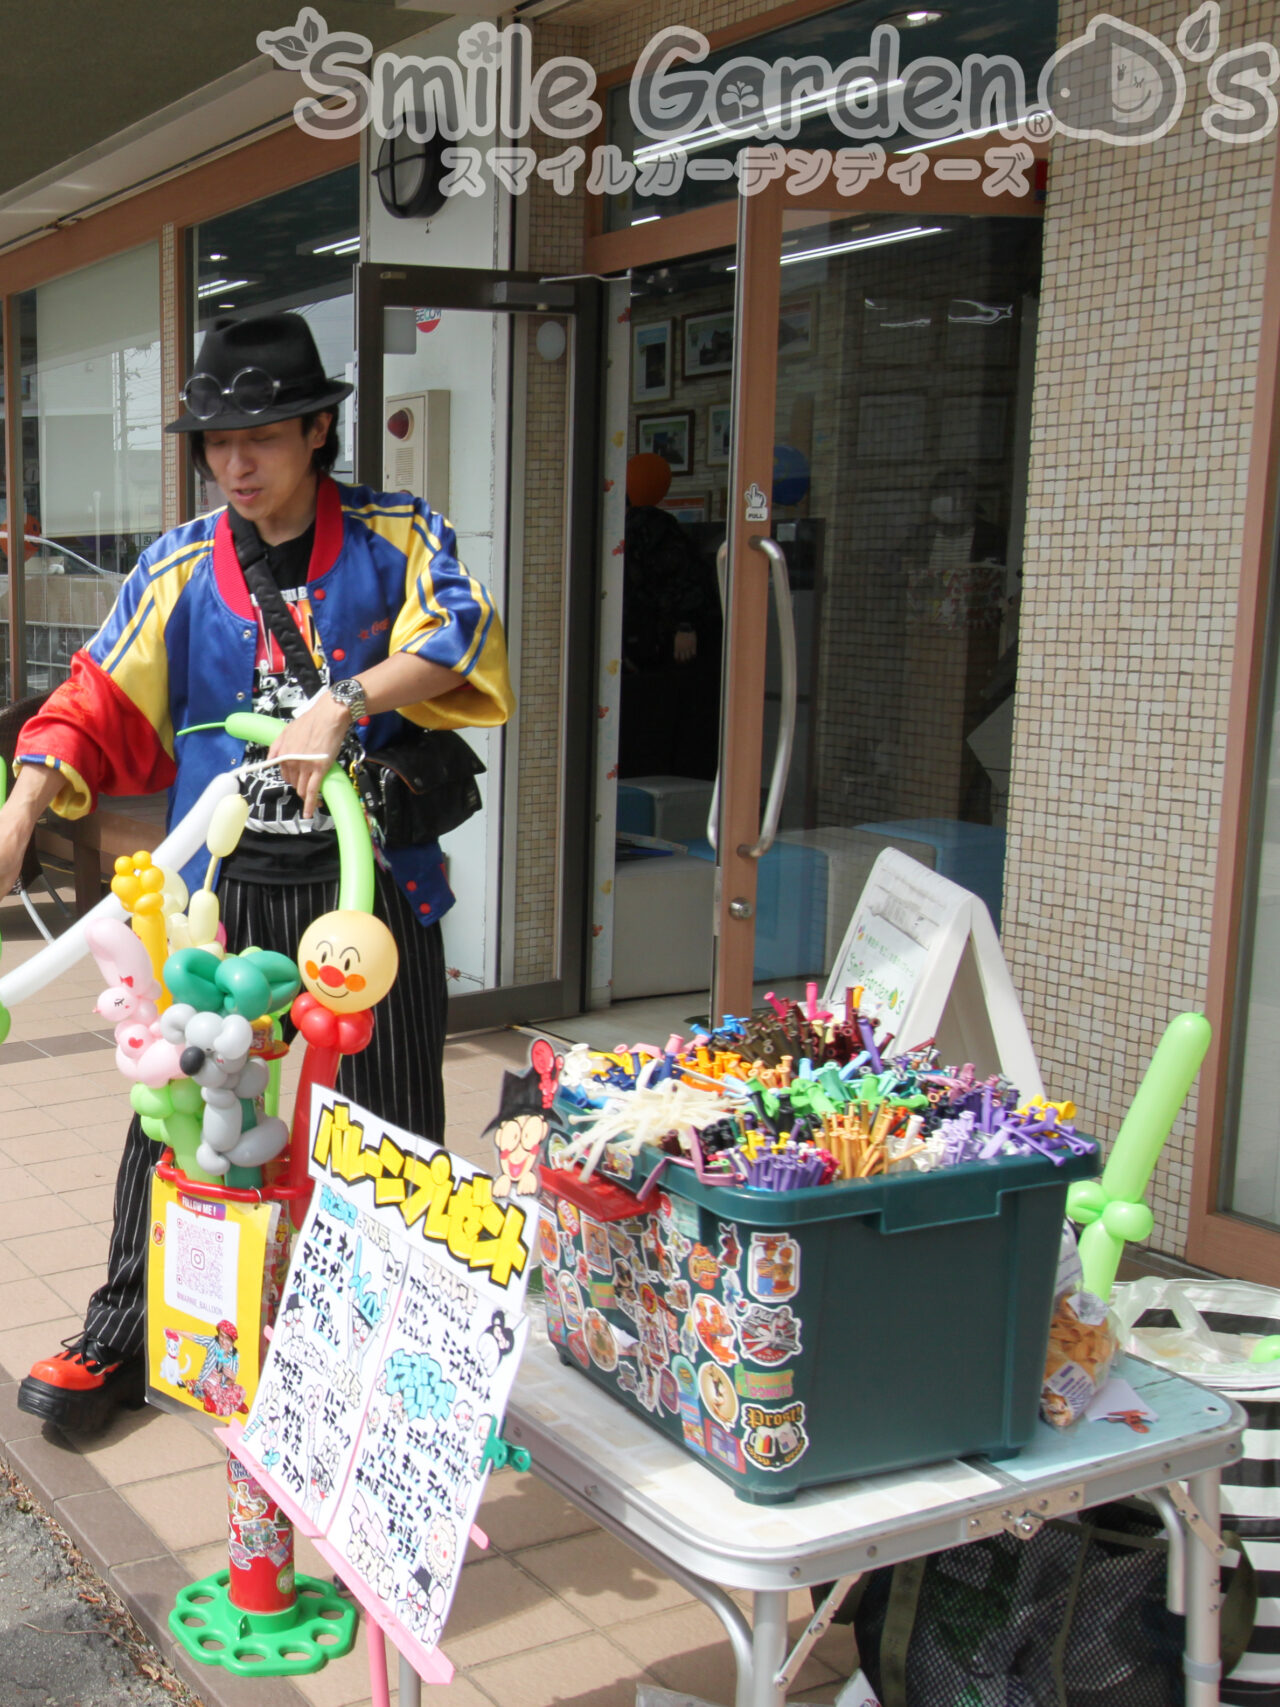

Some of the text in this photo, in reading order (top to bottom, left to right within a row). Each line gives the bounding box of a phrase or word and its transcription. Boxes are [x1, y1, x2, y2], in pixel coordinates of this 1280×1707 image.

[181, 1195, 202, 1213] FOLLOW
[312, 1101, 529, 1288] バルーンプレゼント
[311, 1214, 332, 1247] ケン
[304, 1242, 343, 1293] マシンガン
[293, 1270, 330, 1310] かいぞくの
[314, 1311, 341, 1346] ぼうし
[274, 1351, 303, 1381] チョウチョ
[325, 1389, 346, 1413] ハート
[747, 1406, 803, 1429] Prost!
[383, 1424, 396, 1443] ネコ
[282, 1455, 304, 1492] ティアラ
